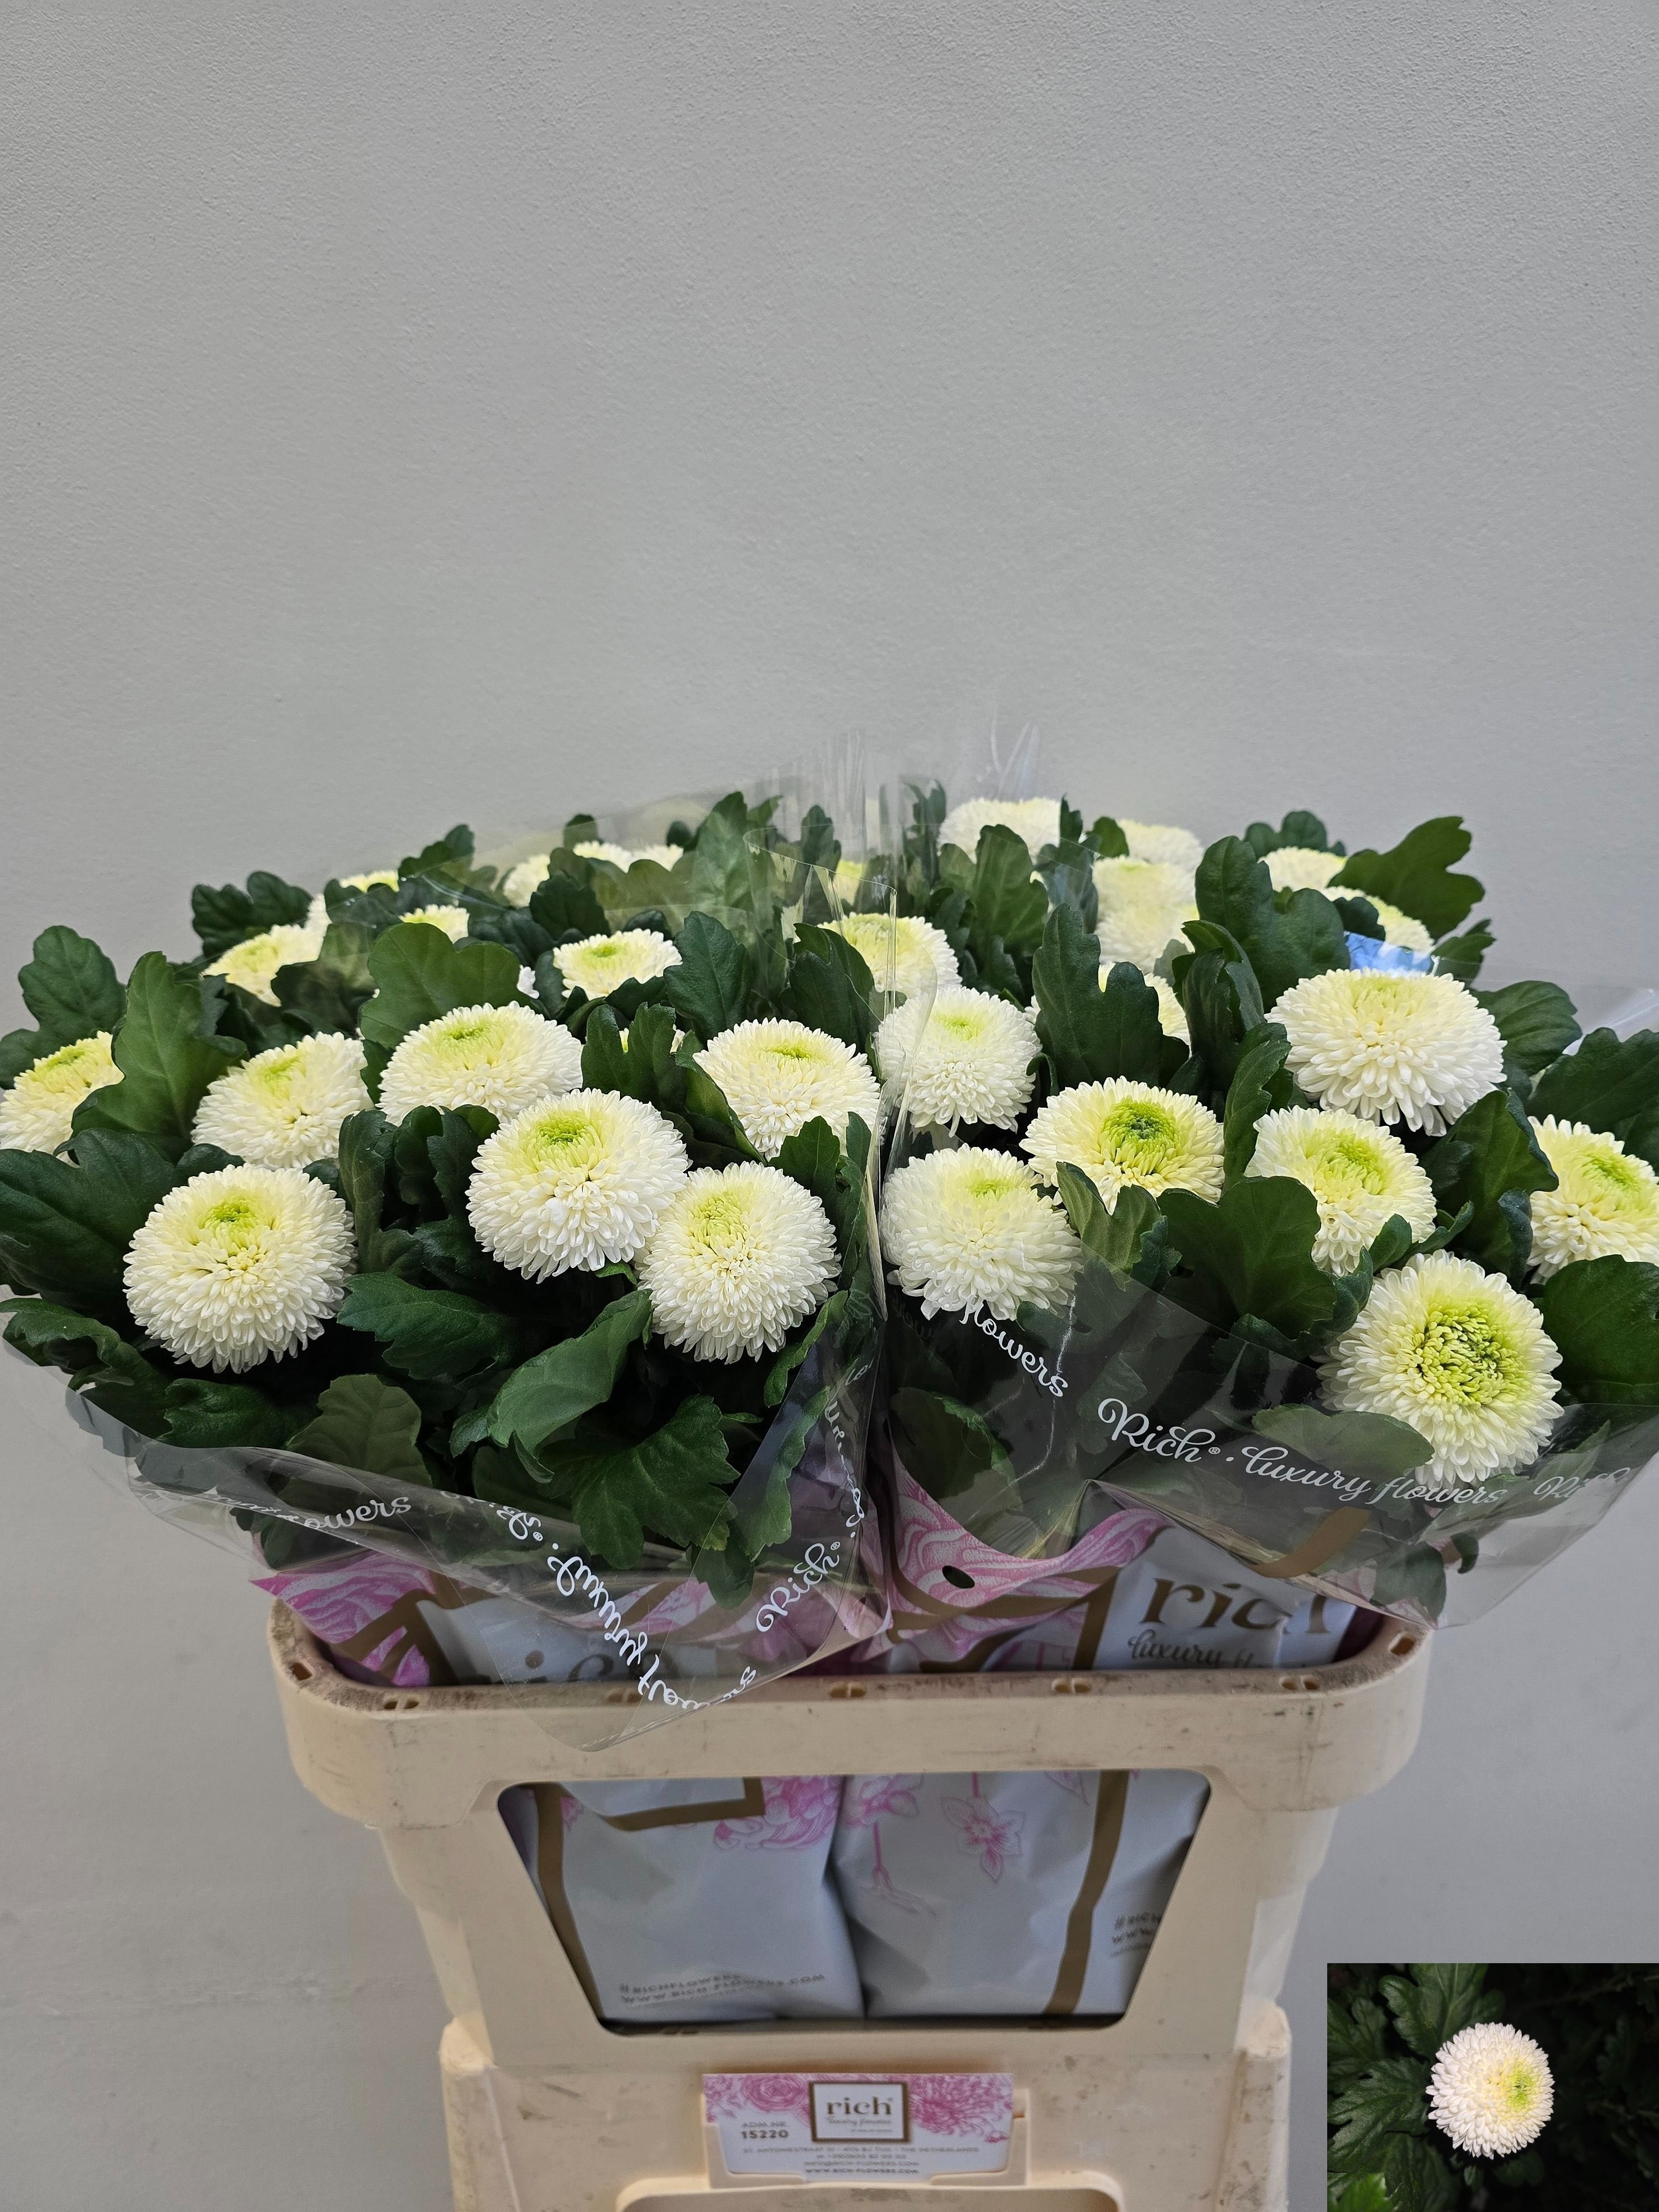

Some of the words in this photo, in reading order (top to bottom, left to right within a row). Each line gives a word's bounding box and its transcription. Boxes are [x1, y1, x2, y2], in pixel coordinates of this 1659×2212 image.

[959, 1294, 1068, 1398] flowers
[1364, 1476, 1509, 1505] flowers
[740, 2130, 789, 2139] 15220
